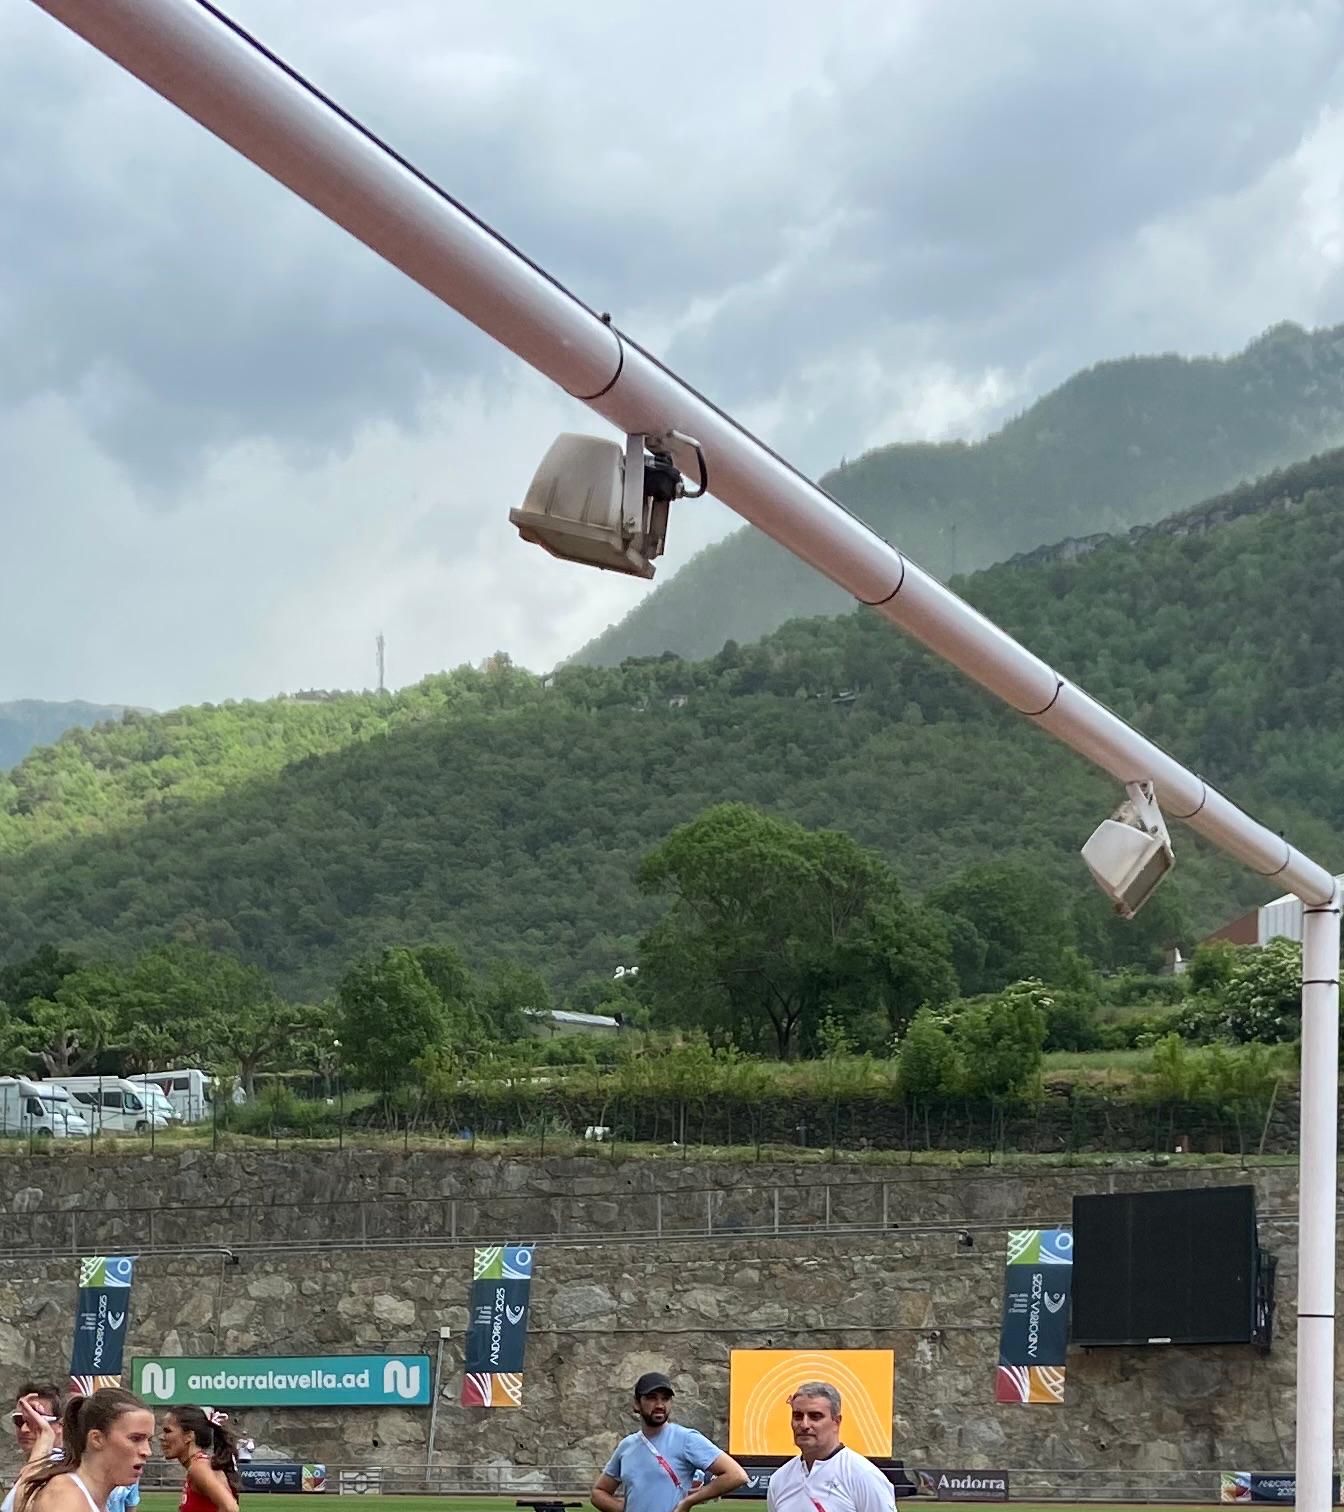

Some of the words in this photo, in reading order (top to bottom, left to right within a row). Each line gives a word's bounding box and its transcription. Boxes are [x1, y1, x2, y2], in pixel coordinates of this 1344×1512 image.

[1031, 1273, 1043, 1300] 2025
[98, 1294, 108, 1319] 2025
[495, 1287, 506, 1313] 2025
[489, 1313, 503, 1366] ANDORRA
[1027, 1300, 1040, 1358] ANDORRA
[93, 1319, 105, 1369] ANDORRA
[187, 1370, 369, 1389] andorralavella.ad
[937, 1474, 1006, 1489] Andorra
